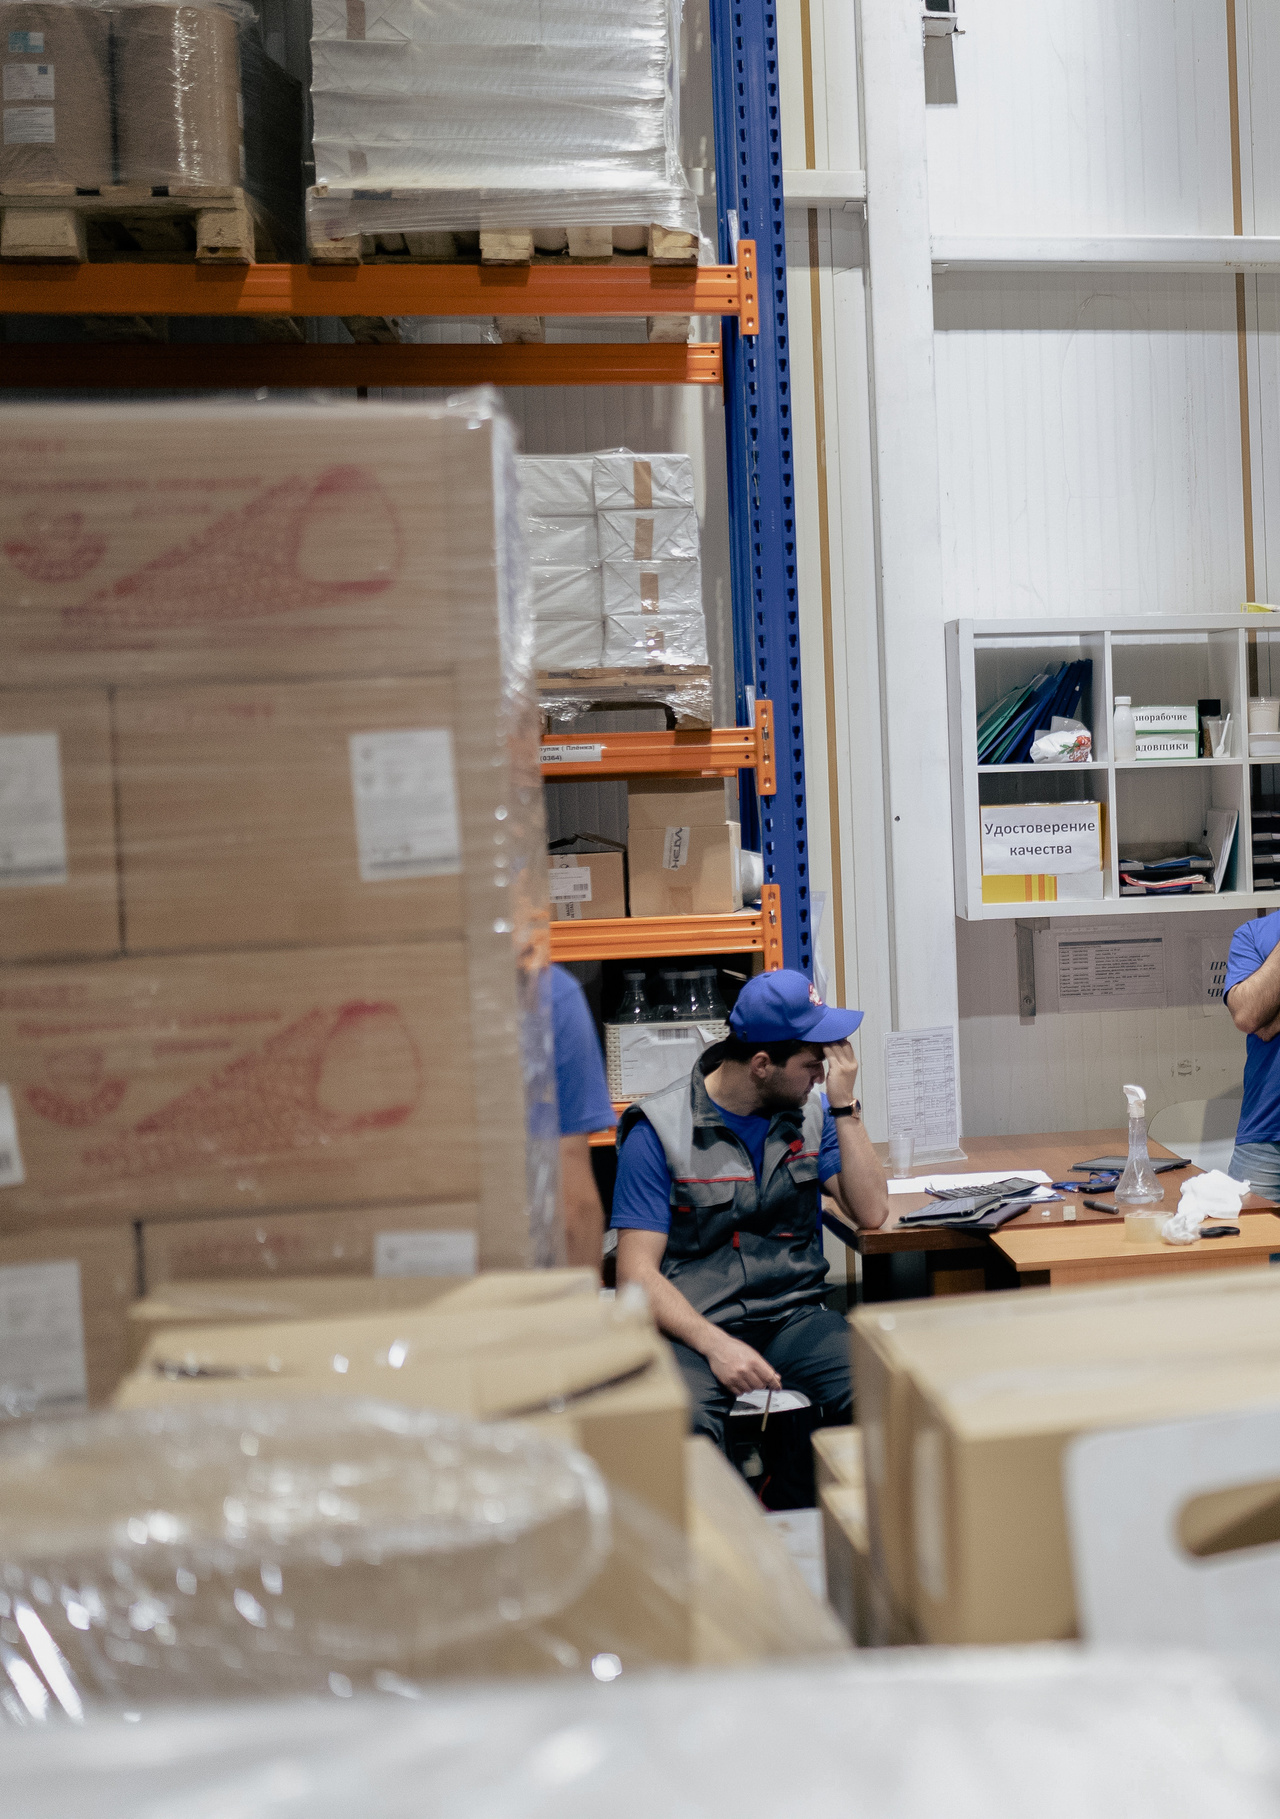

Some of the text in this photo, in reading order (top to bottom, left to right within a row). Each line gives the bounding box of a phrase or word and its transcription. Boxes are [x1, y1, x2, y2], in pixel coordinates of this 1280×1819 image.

[1135, 743, 1189, 752] адовщики
[984, 821, 1096, 837] Удостоверение
[1010, 845, 1072, 856] качества
